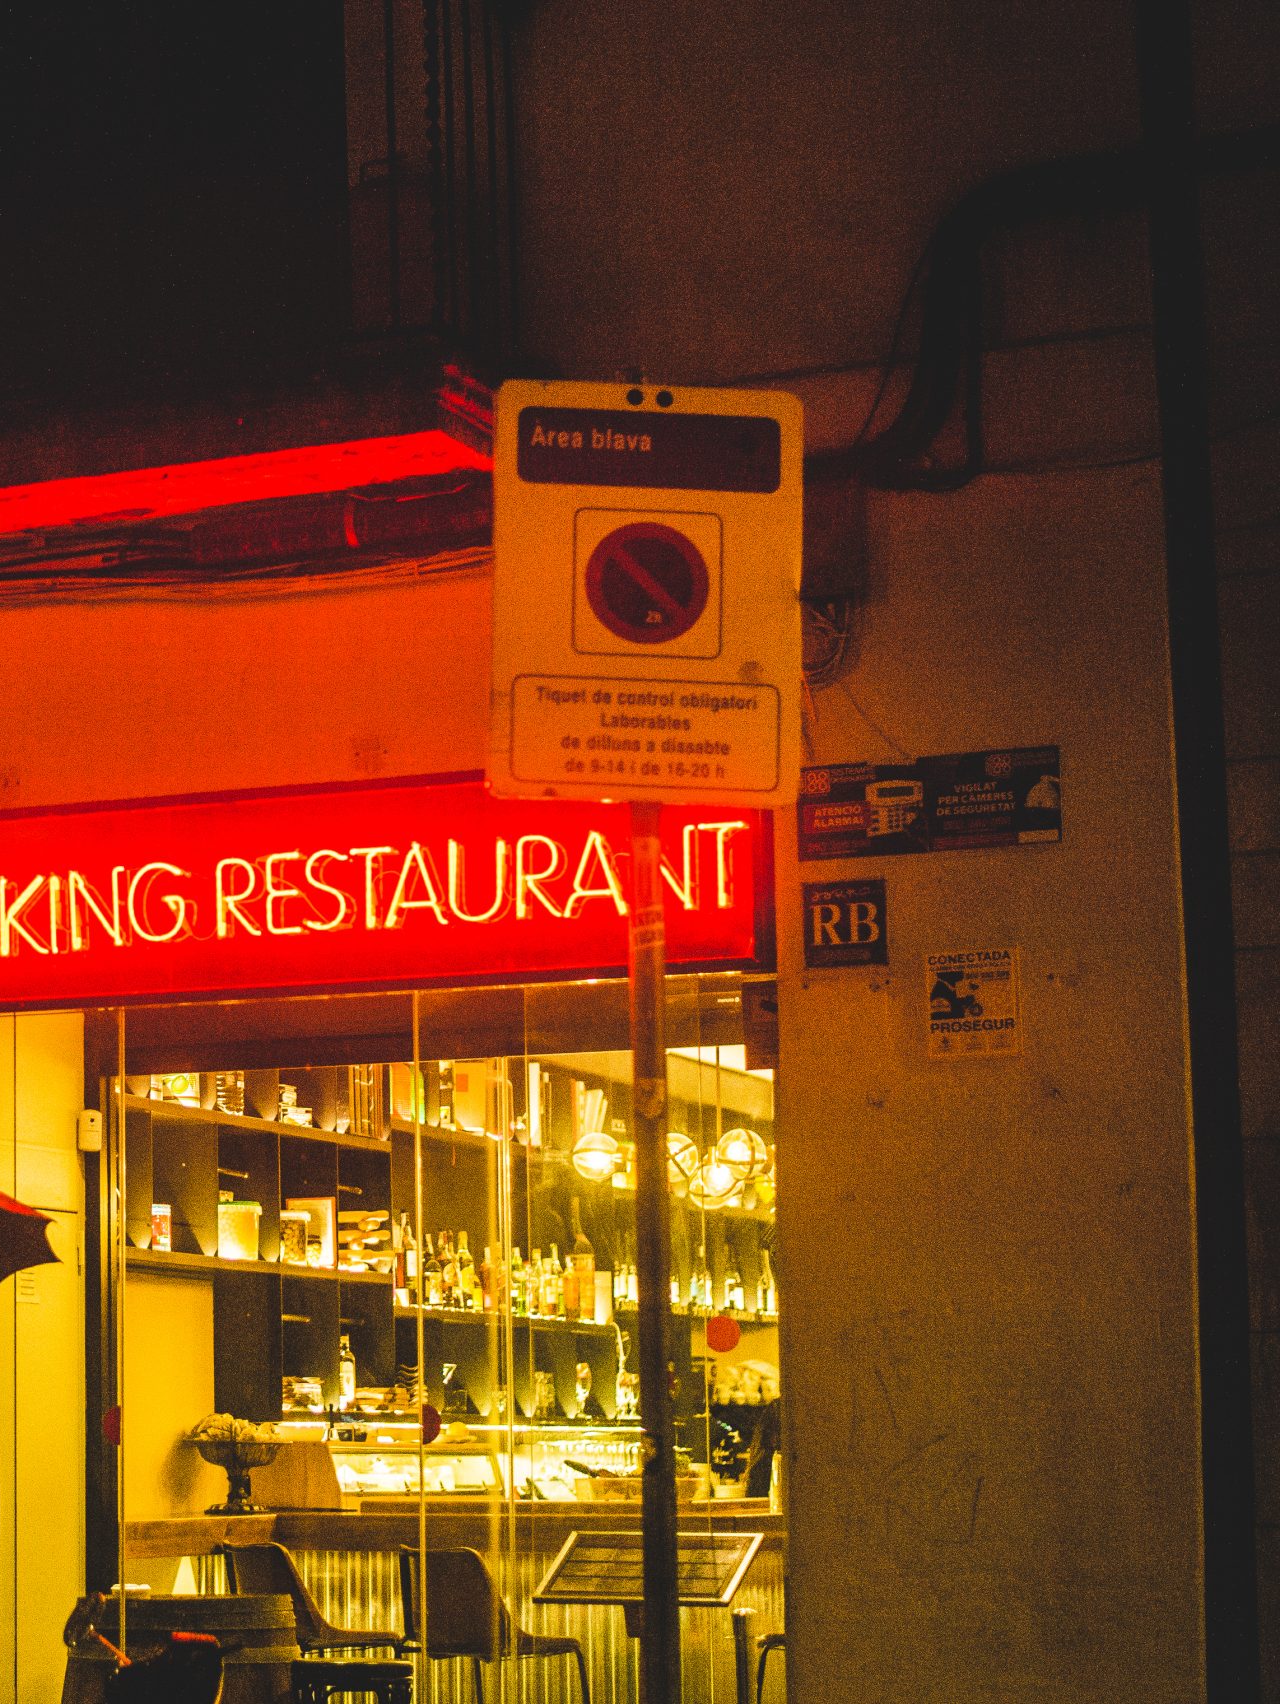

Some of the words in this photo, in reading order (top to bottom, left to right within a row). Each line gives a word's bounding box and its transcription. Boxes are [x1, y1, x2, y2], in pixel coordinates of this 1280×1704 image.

[591, 427, 652, 452] blava
[536, 686, 586, 705] Tiquet
[592, 690, 612, 704] de
[617, 692, 674, 707] control
[680, 694, 758, 713] obligatori
[600, 713, 691, 731] Laborables
[560, 735, 581, 750] de
[586, 736, 641, 752] dilluns
[646, 740, 656, 753] a
[661, 739, 730, 756] dissabte
[565, 757, 585, 773] de
[641, 761, 661, 776] de
[953, 781, 998, 793] VIGILAT
[937, 796, 960, 805] PER
[936, 807, 952, 816] DE
[216, 820, 750, 938] RESTAURANT
[810, 902, 880, 946] RB
[928, 950, 1011, 965] CONECTADA
[930, 1017, 1015, 1034] PROSEGUR
